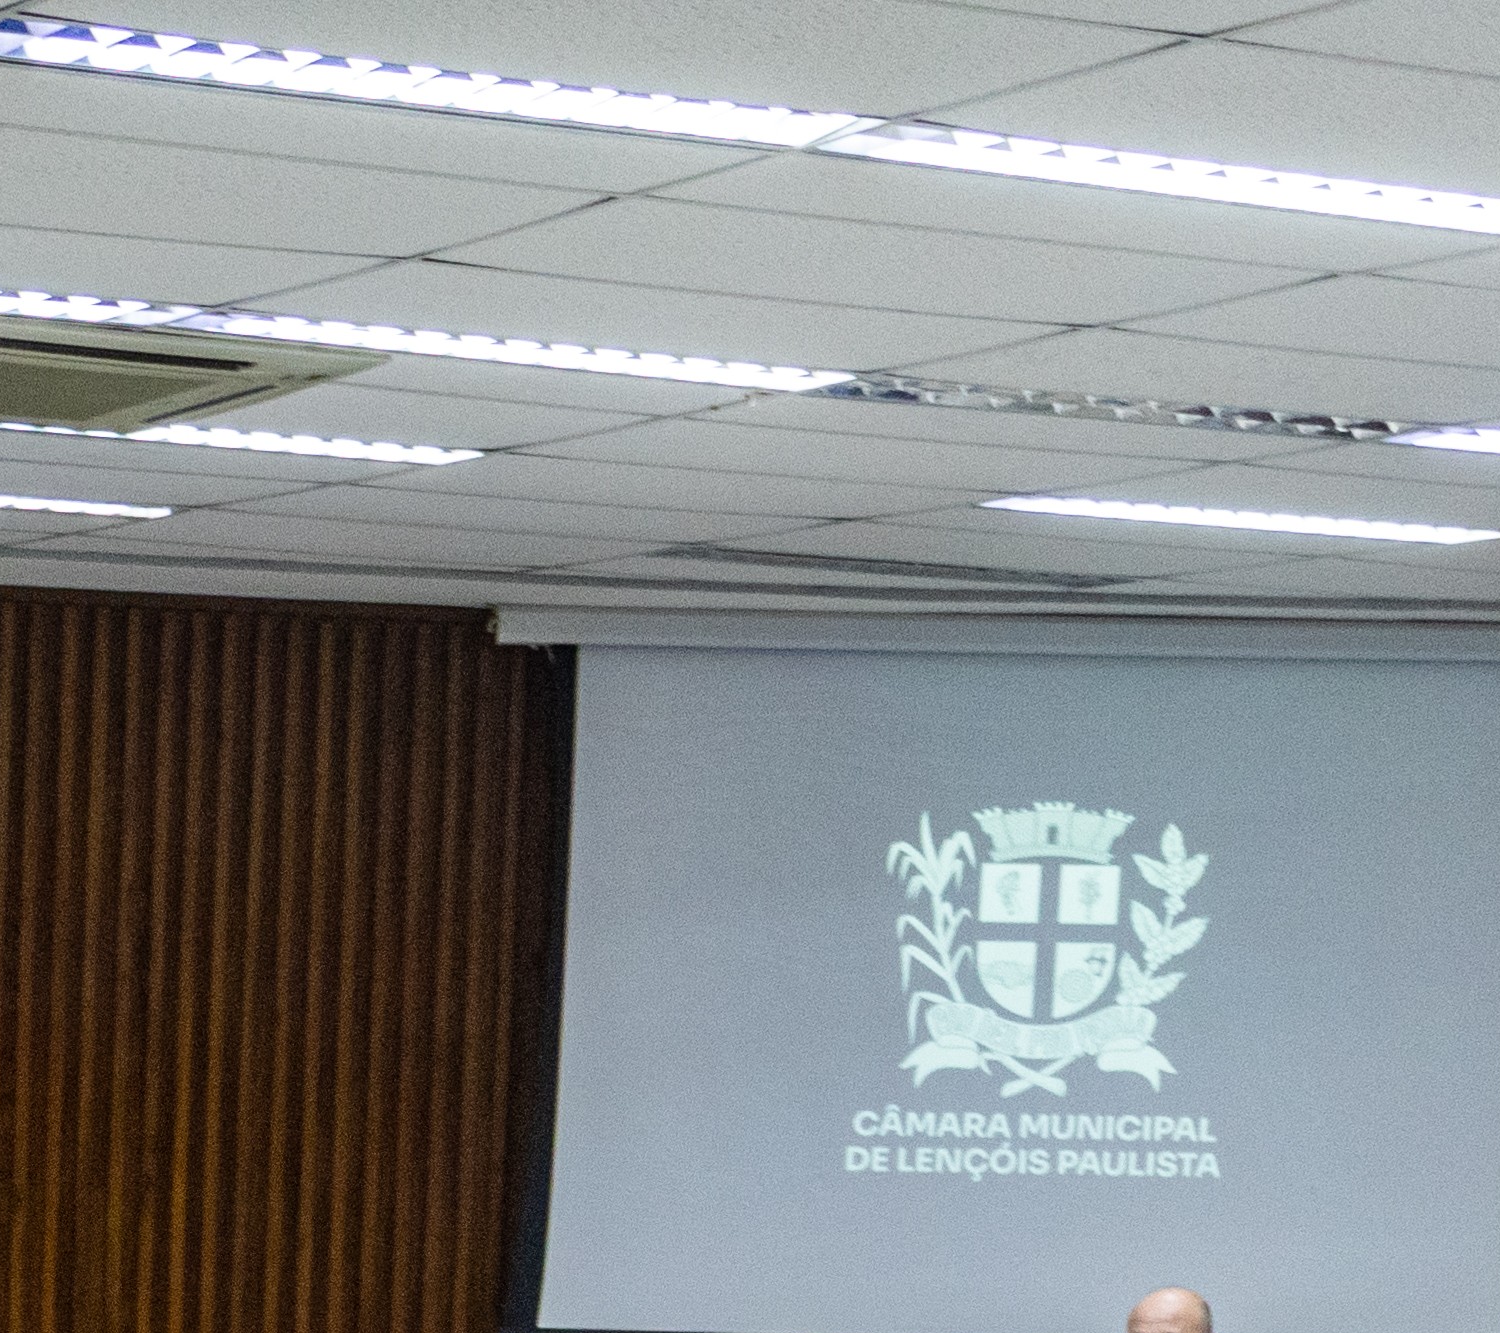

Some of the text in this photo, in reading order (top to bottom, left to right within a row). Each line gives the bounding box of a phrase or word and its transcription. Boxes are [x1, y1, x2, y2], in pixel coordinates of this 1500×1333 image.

[852, 1103, 1218, 1143] CÂMARA MUNICIPAL
[844, 1141, 1222, 1182] DE LENÇÓIS PAULISTA
